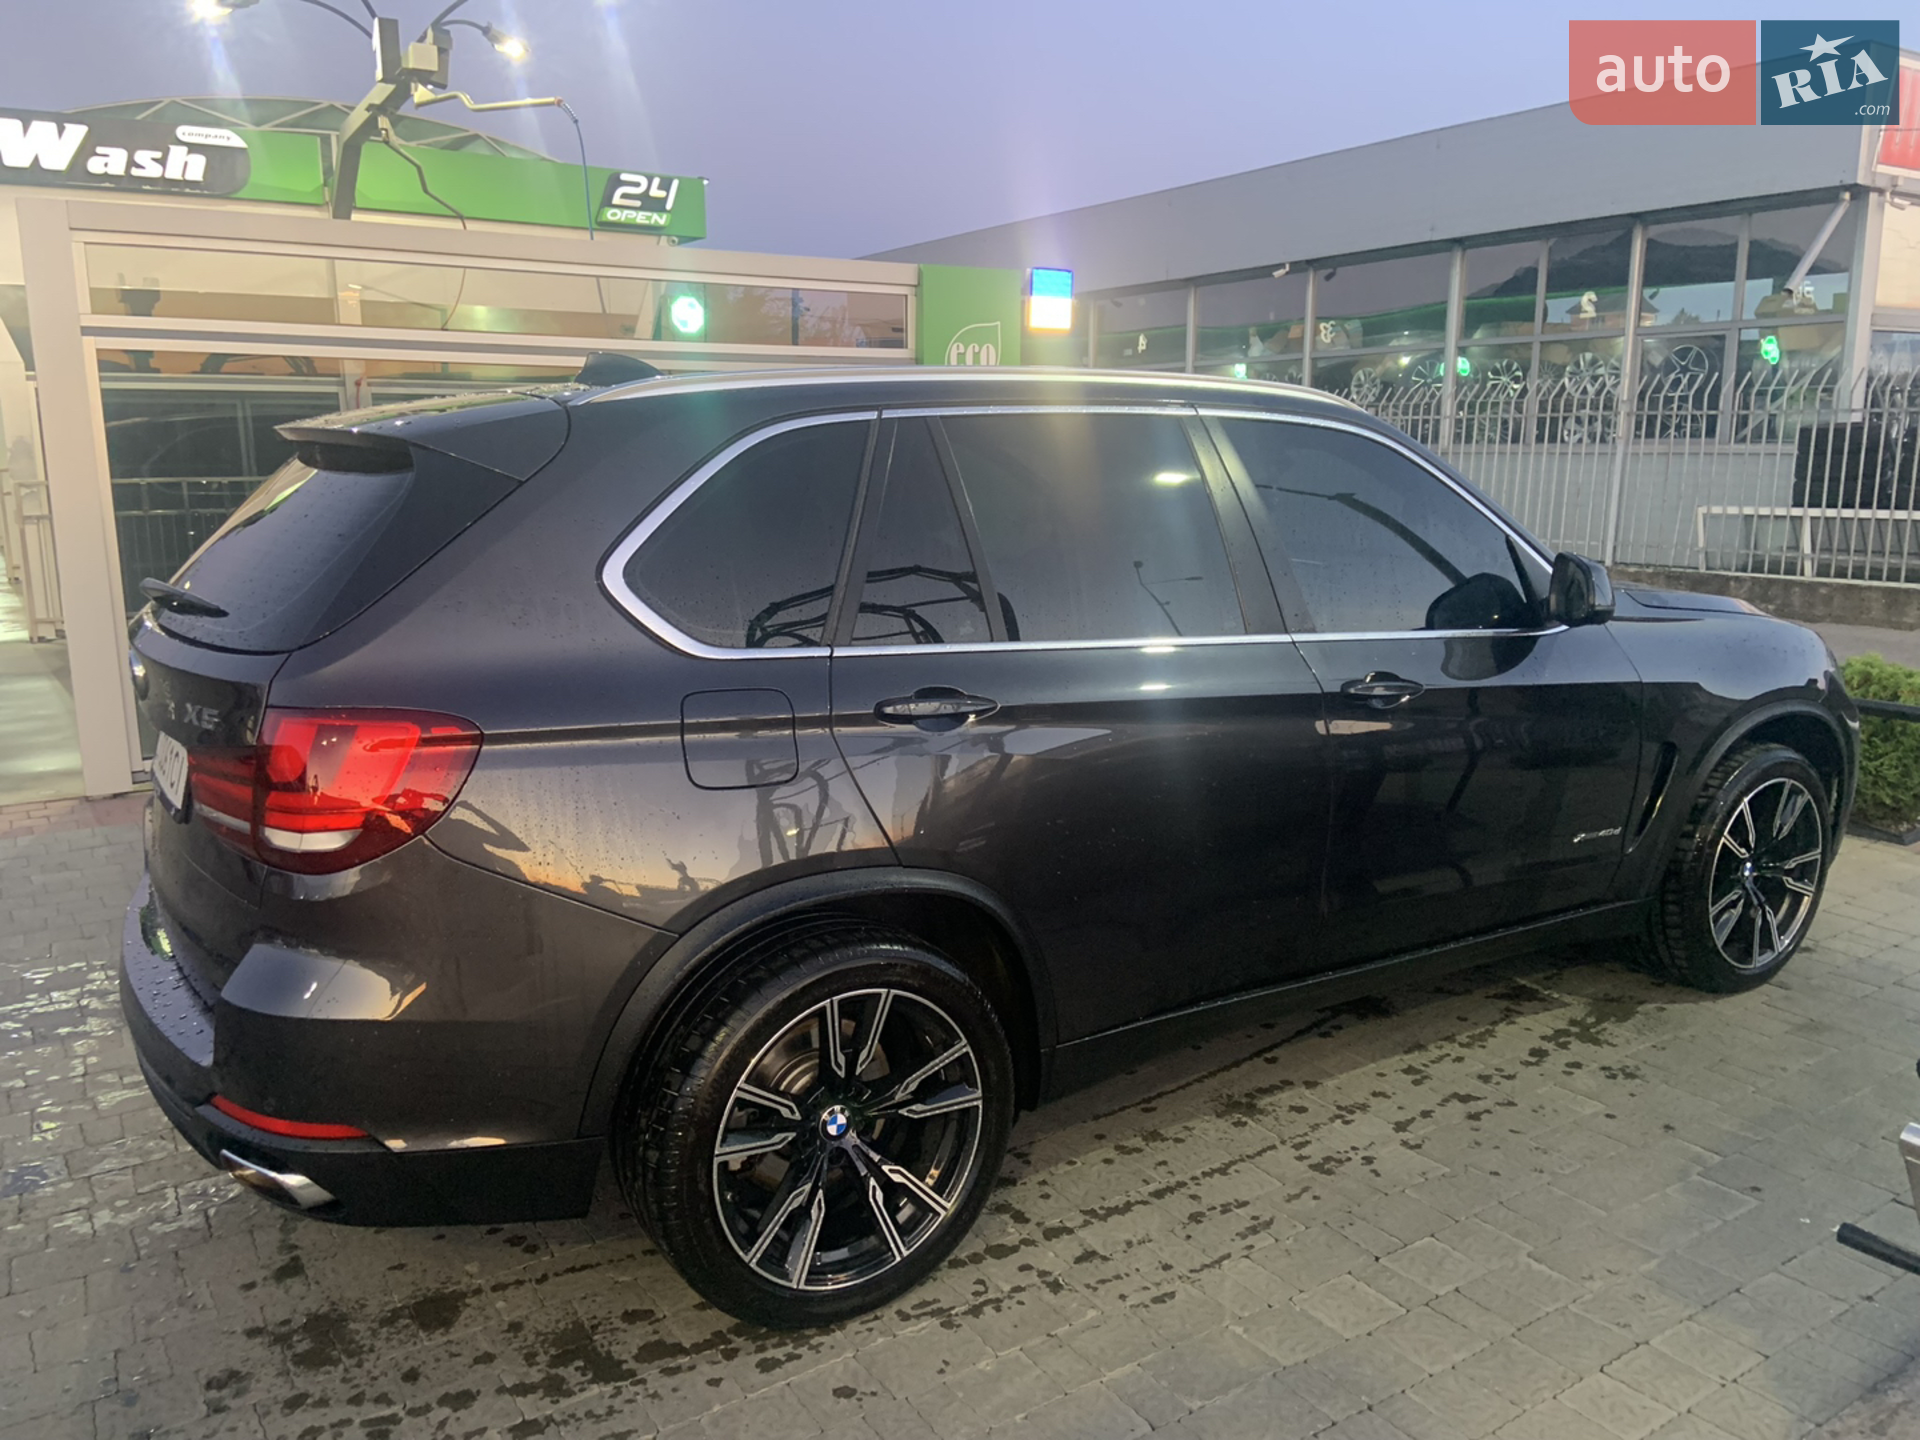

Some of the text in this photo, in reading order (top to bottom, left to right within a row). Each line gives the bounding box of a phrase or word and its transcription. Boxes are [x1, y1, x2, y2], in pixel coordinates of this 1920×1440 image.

[0, 117, 207, 182] Wash
[611, 172, 680, 211] 24
[606, 208, 667, 225] OPEN
